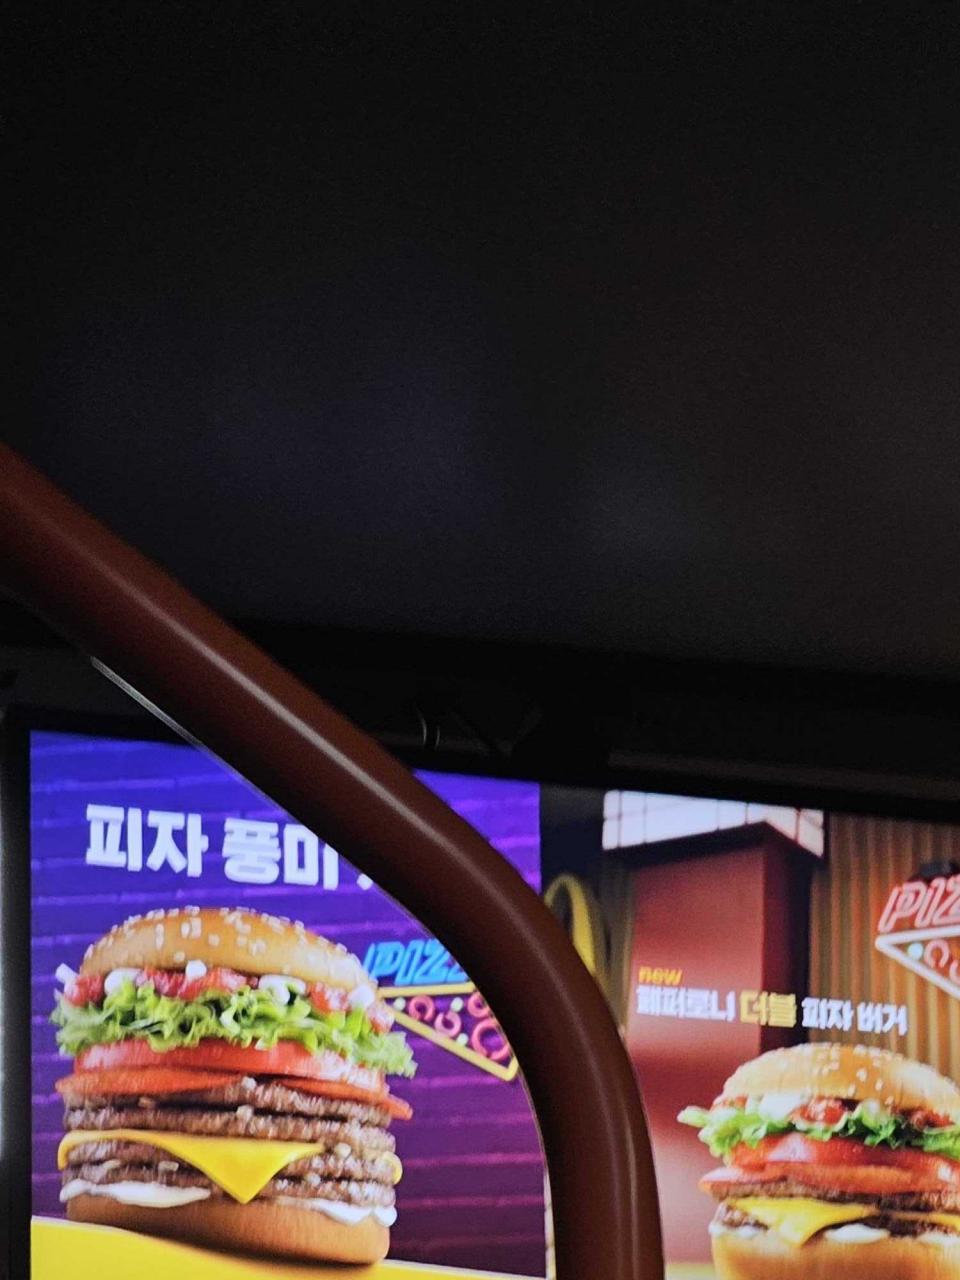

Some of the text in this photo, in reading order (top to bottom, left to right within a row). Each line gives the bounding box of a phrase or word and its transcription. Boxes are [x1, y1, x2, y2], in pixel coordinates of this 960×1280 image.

[86, 804, 339, 890] 피자 풍미
[638, 966, 682, 985] new
[636, 985, 907, 1036] 페퍼로니 더블 피자 버거
